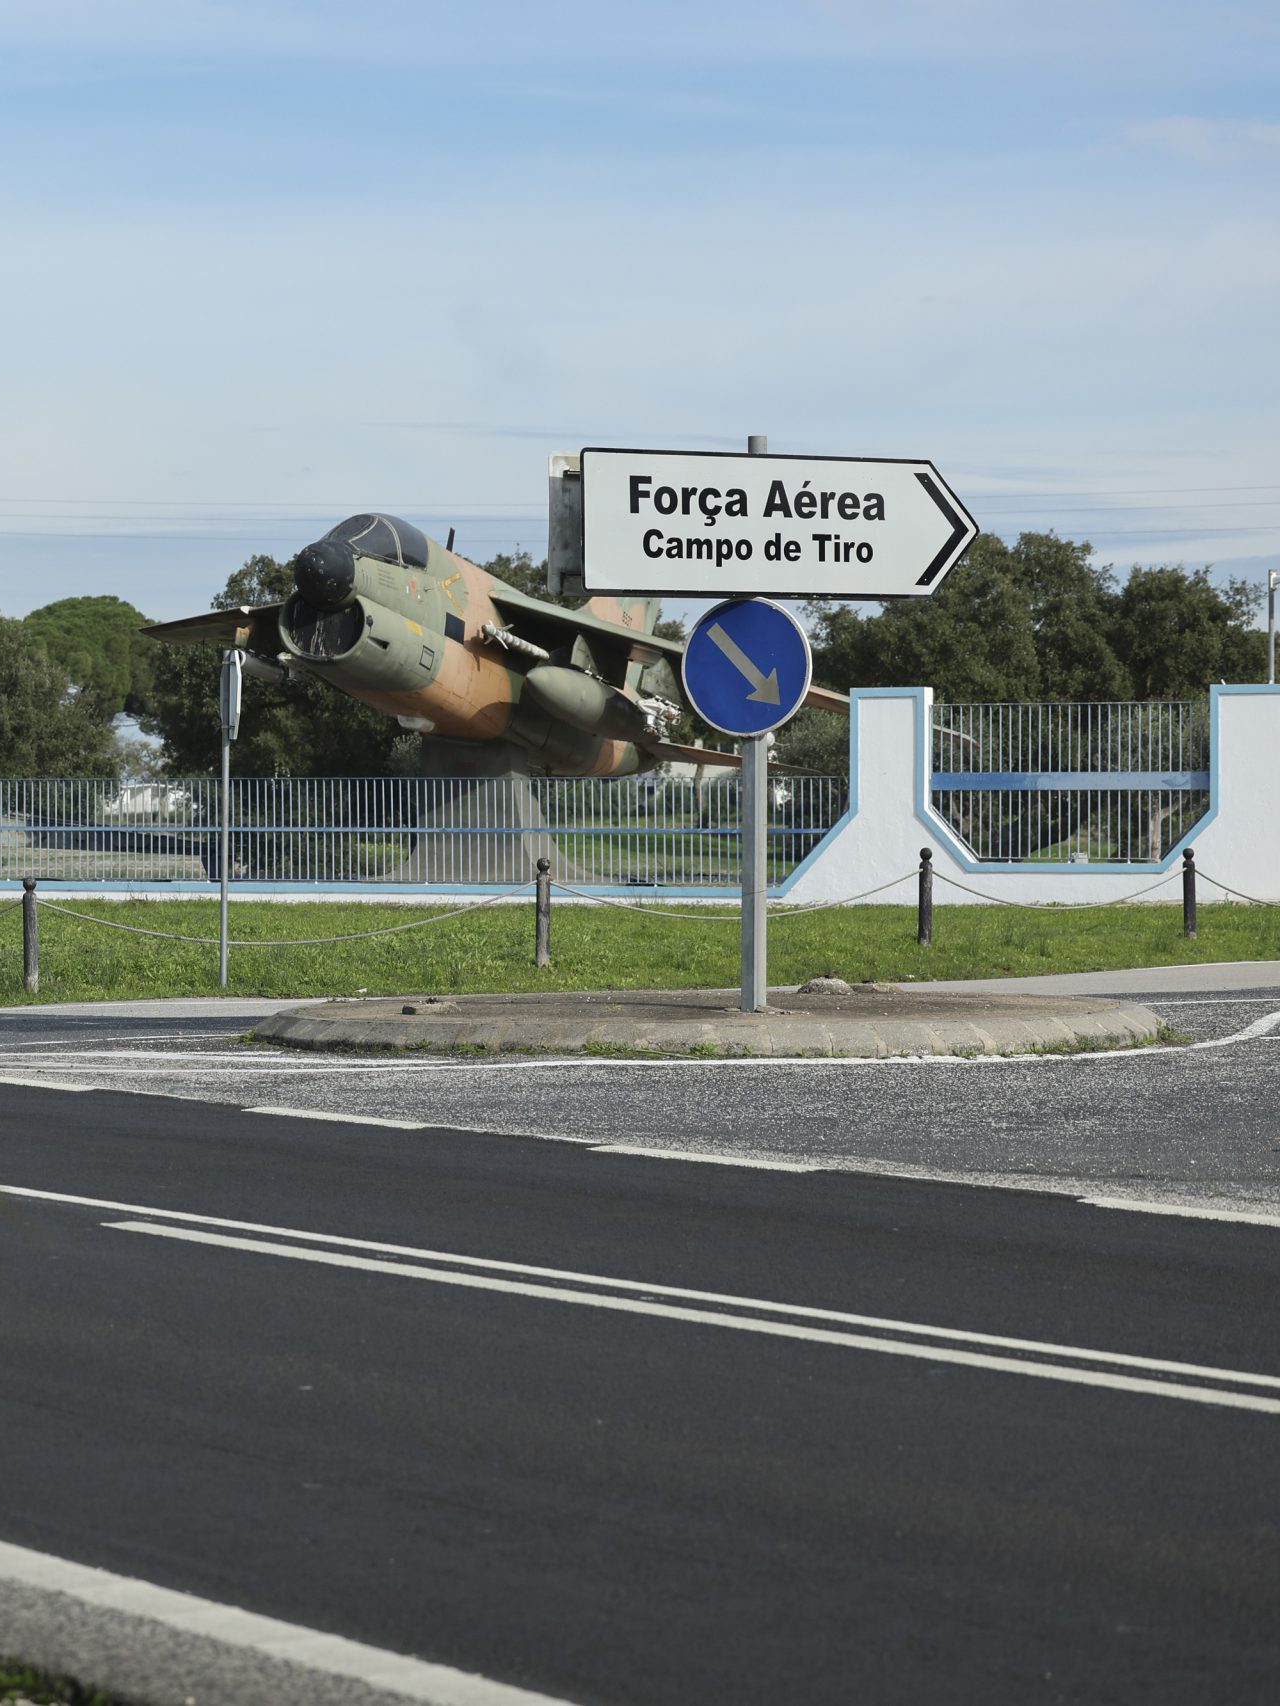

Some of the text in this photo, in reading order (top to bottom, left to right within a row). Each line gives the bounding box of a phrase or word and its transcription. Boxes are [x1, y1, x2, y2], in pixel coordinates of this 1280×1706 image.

[629, 475, 886, 526] Força Aérea
[642, 528, 874, 567] Campo de Tiro
